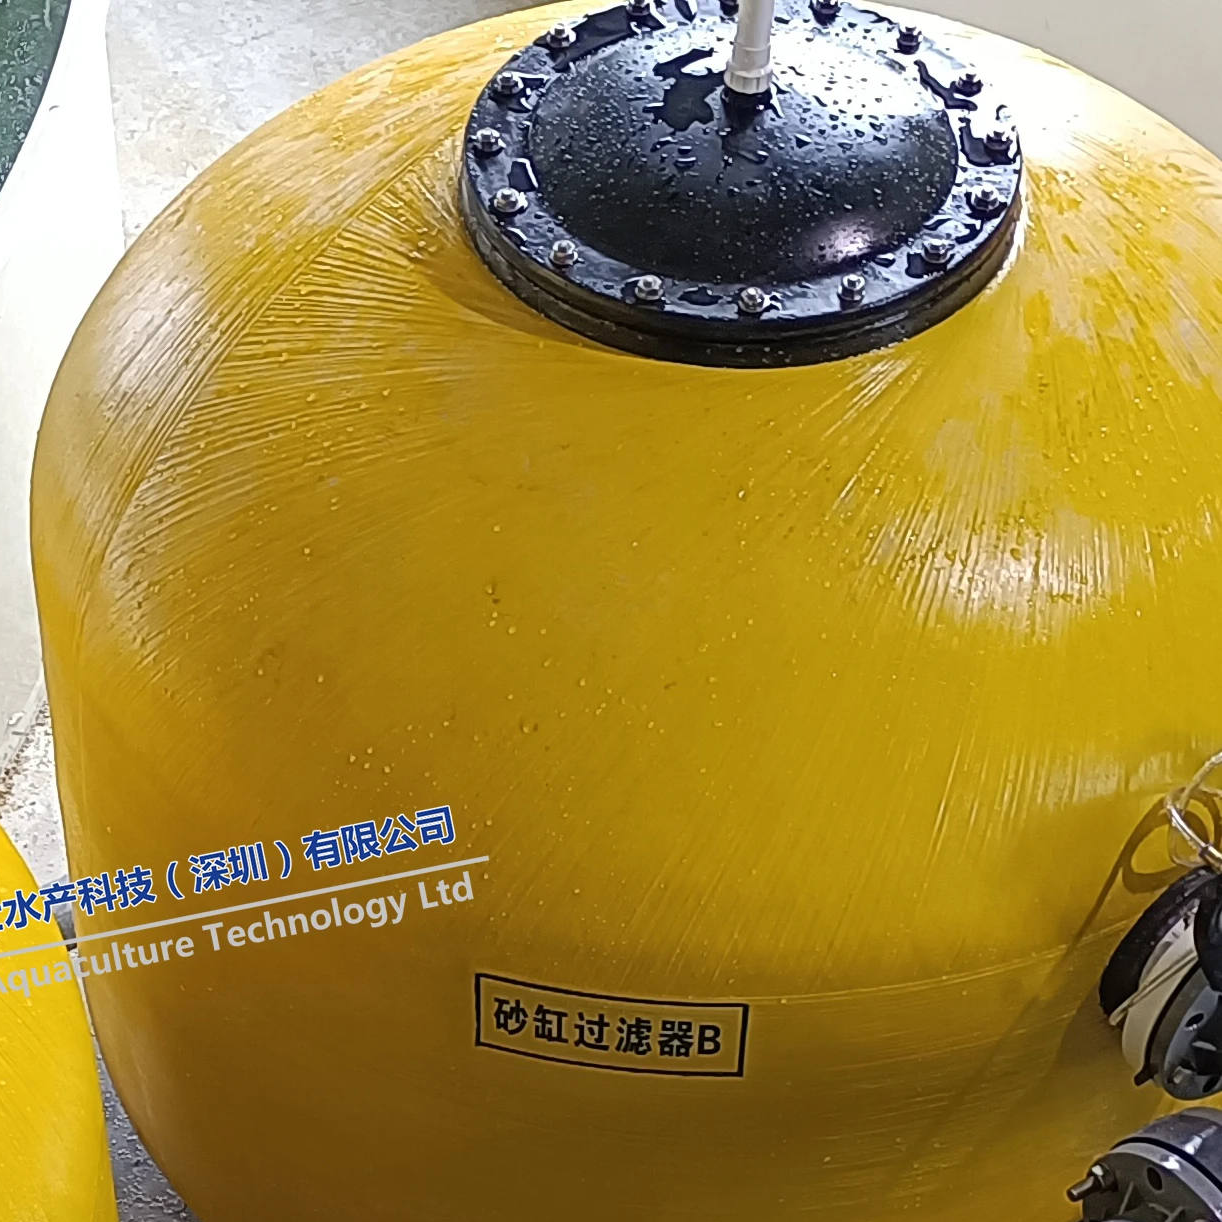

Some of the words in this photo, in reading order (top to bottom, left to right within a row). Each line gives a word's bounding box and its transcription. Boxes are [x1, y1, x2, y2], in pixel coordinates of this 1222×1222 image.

[493, 997, 721, 1058] 砂缸过滤器B
